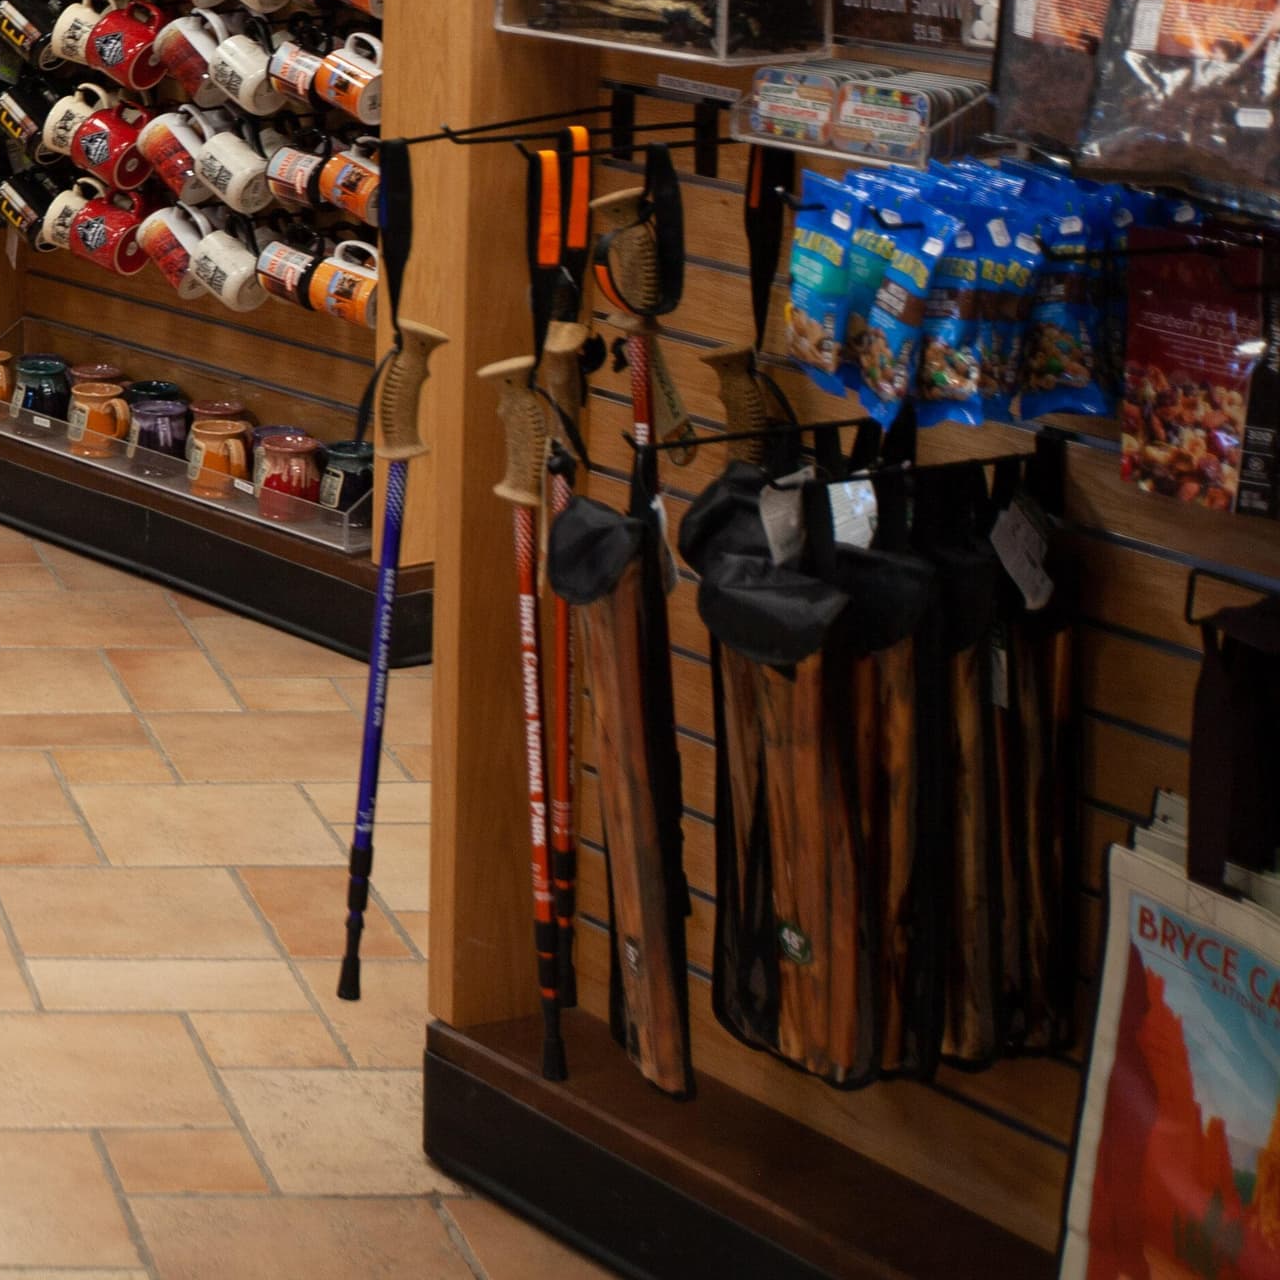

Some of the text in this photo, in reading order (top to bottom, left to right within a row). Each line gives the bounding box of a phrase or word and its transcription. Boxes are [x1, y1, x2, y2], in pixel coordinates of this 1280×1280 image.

[381, 567, 396, 602] KEEP
[379, 604, 393, 640] CALM
[376, 642, 389, 671] AND
[374, 672, 387, 704] HIKE
[518, 593, 547, 847] BRYCE CANYON NATIONAL PARK
[1137, 904, 1239, 987] BRYCE
